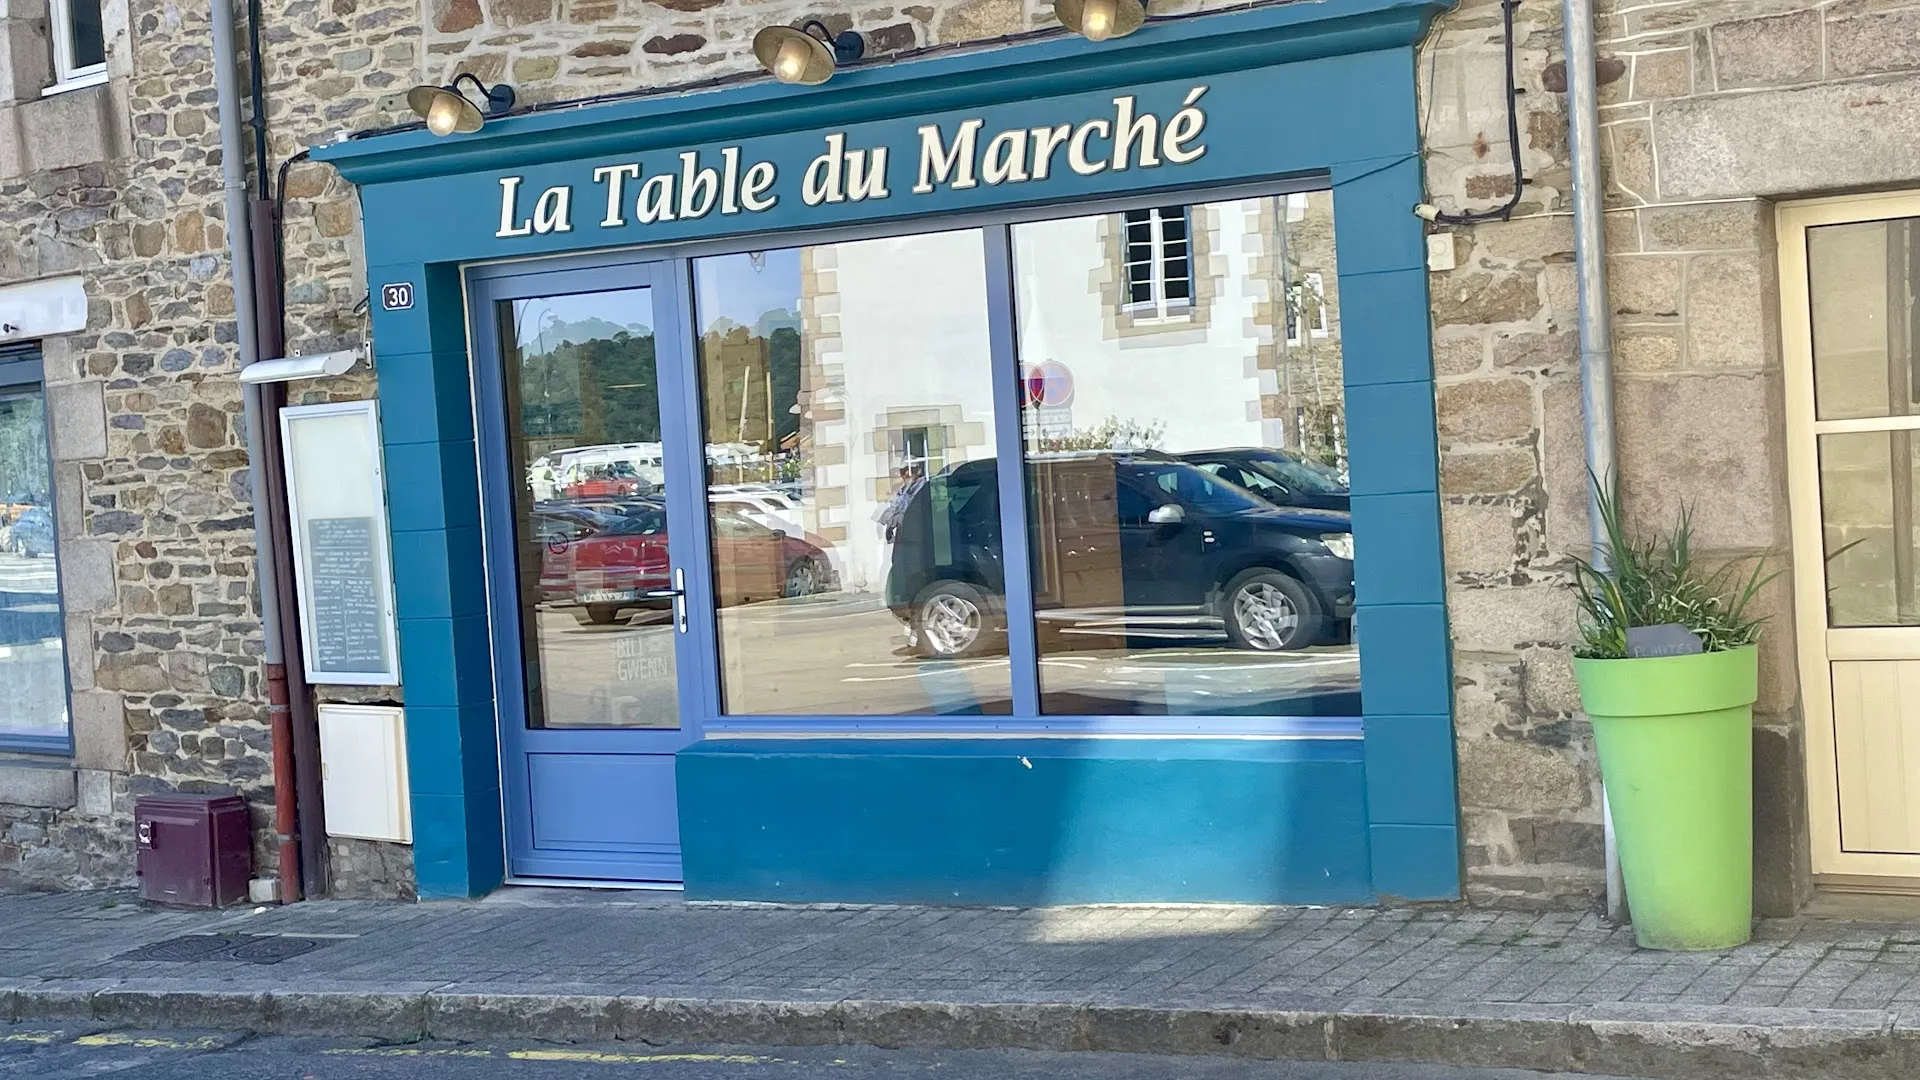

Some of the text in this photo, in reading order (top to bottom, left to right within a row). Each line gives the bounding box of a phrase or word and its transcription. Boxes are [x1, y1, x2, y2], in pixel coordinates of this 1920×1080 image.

[495, 85, 1209, 239] La Table du Marché
[388, 287, 409, 307] 30
